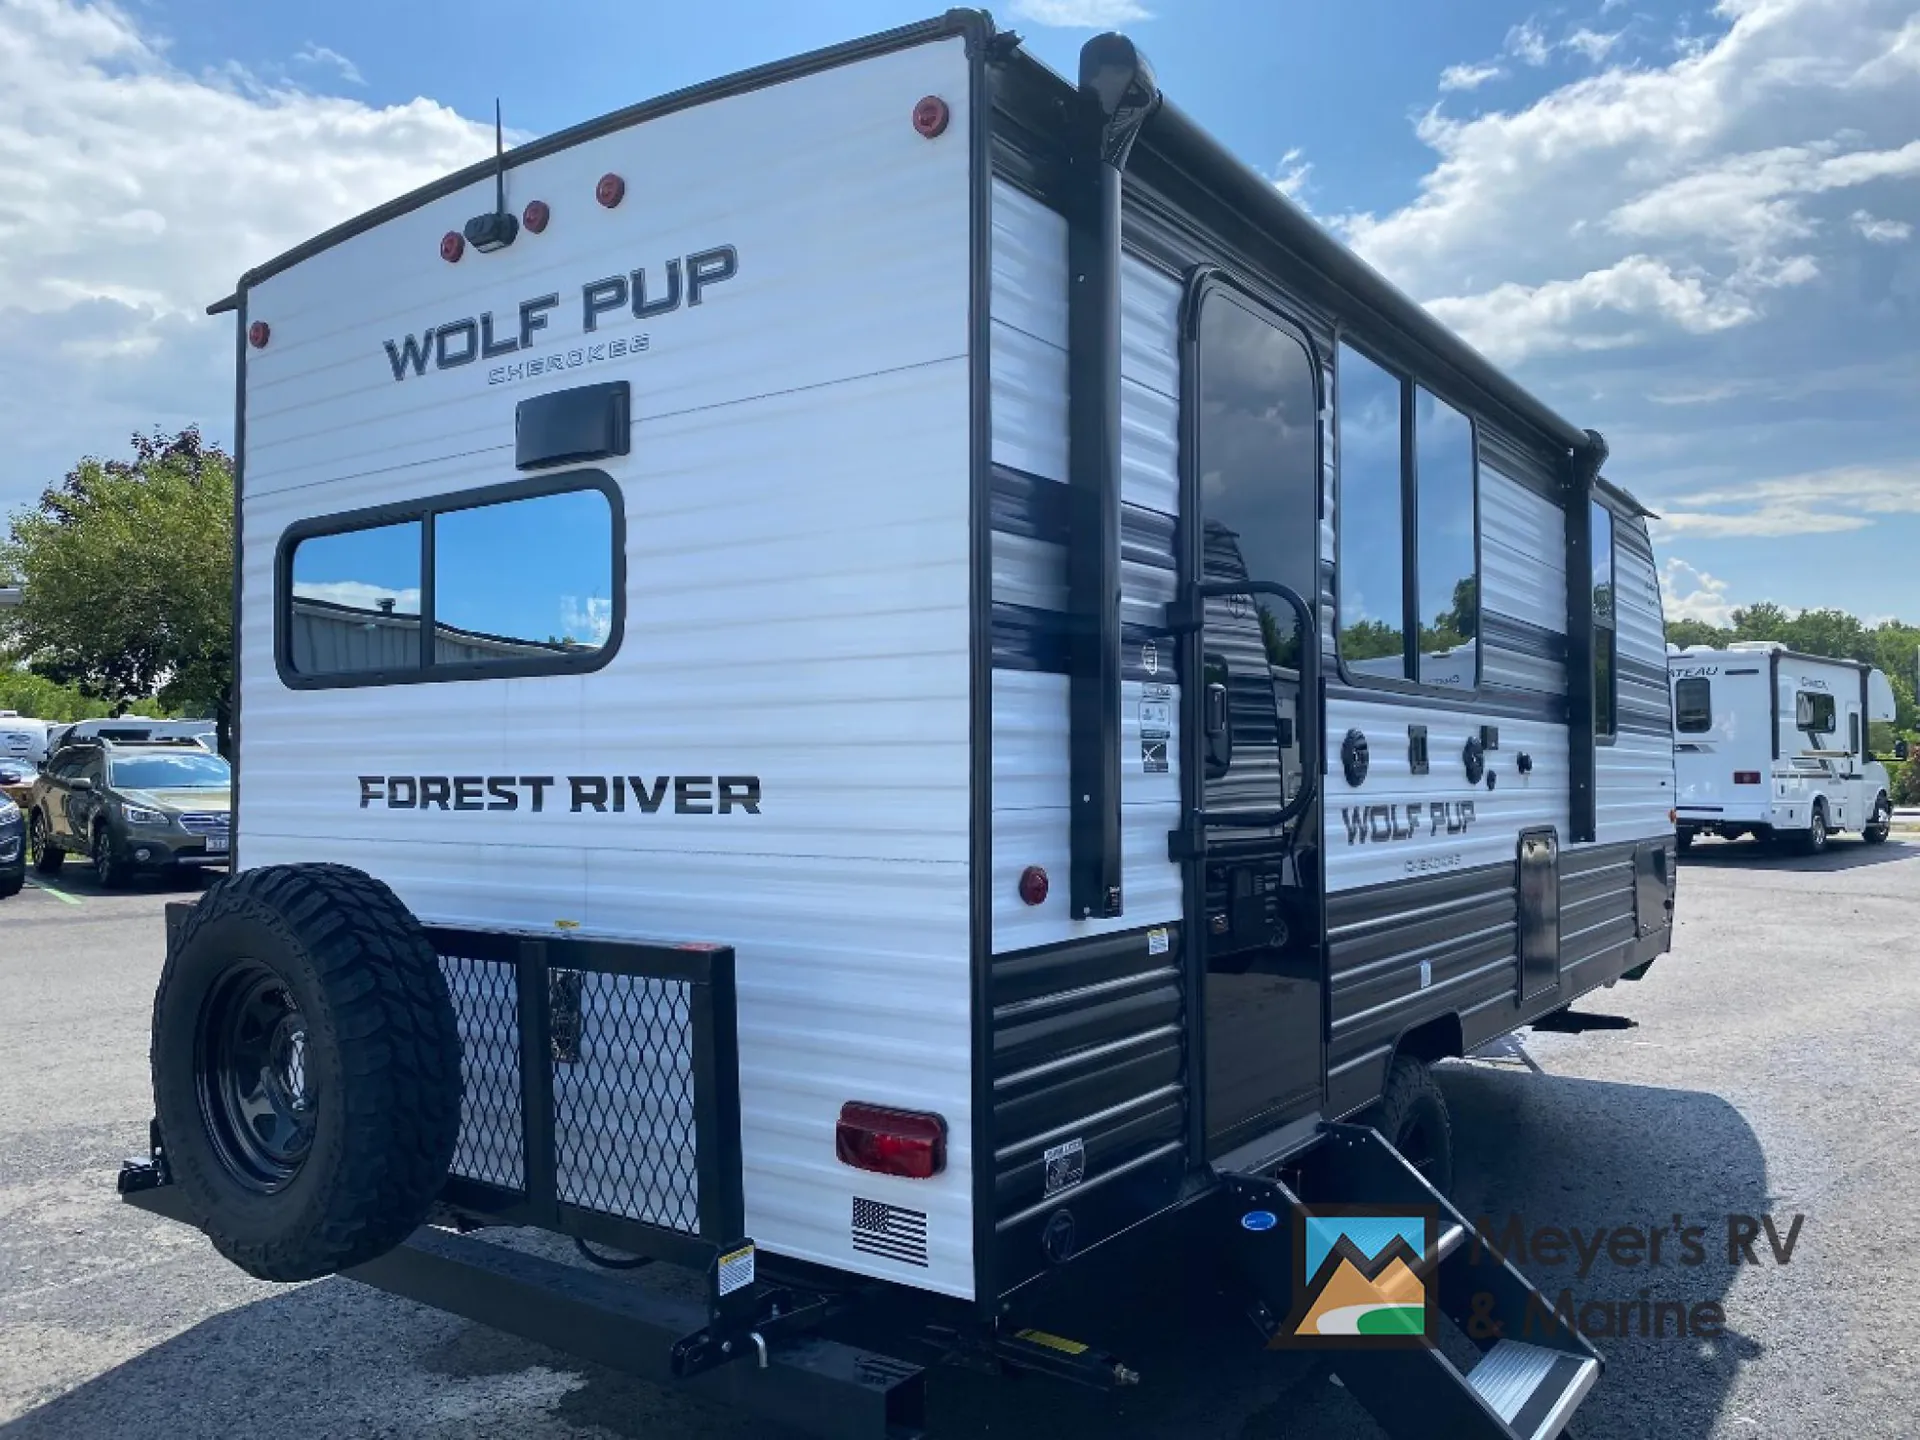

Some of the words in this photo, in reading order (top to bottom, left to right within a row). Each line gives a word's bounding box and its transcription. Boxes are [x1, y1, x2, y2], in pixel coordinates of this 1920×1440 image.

[382, 291, 560, 381] WOLF
[582, 243, 740, 334] PUP
[487, 333, 651, 386] CHEROKEE
[357, 775, 555, 812] FOREST
[566, 775, 762, 815] RIVER
[1341, 802, 1422, 846] WOLF
[1429, 800, 1476, 837] PUP
